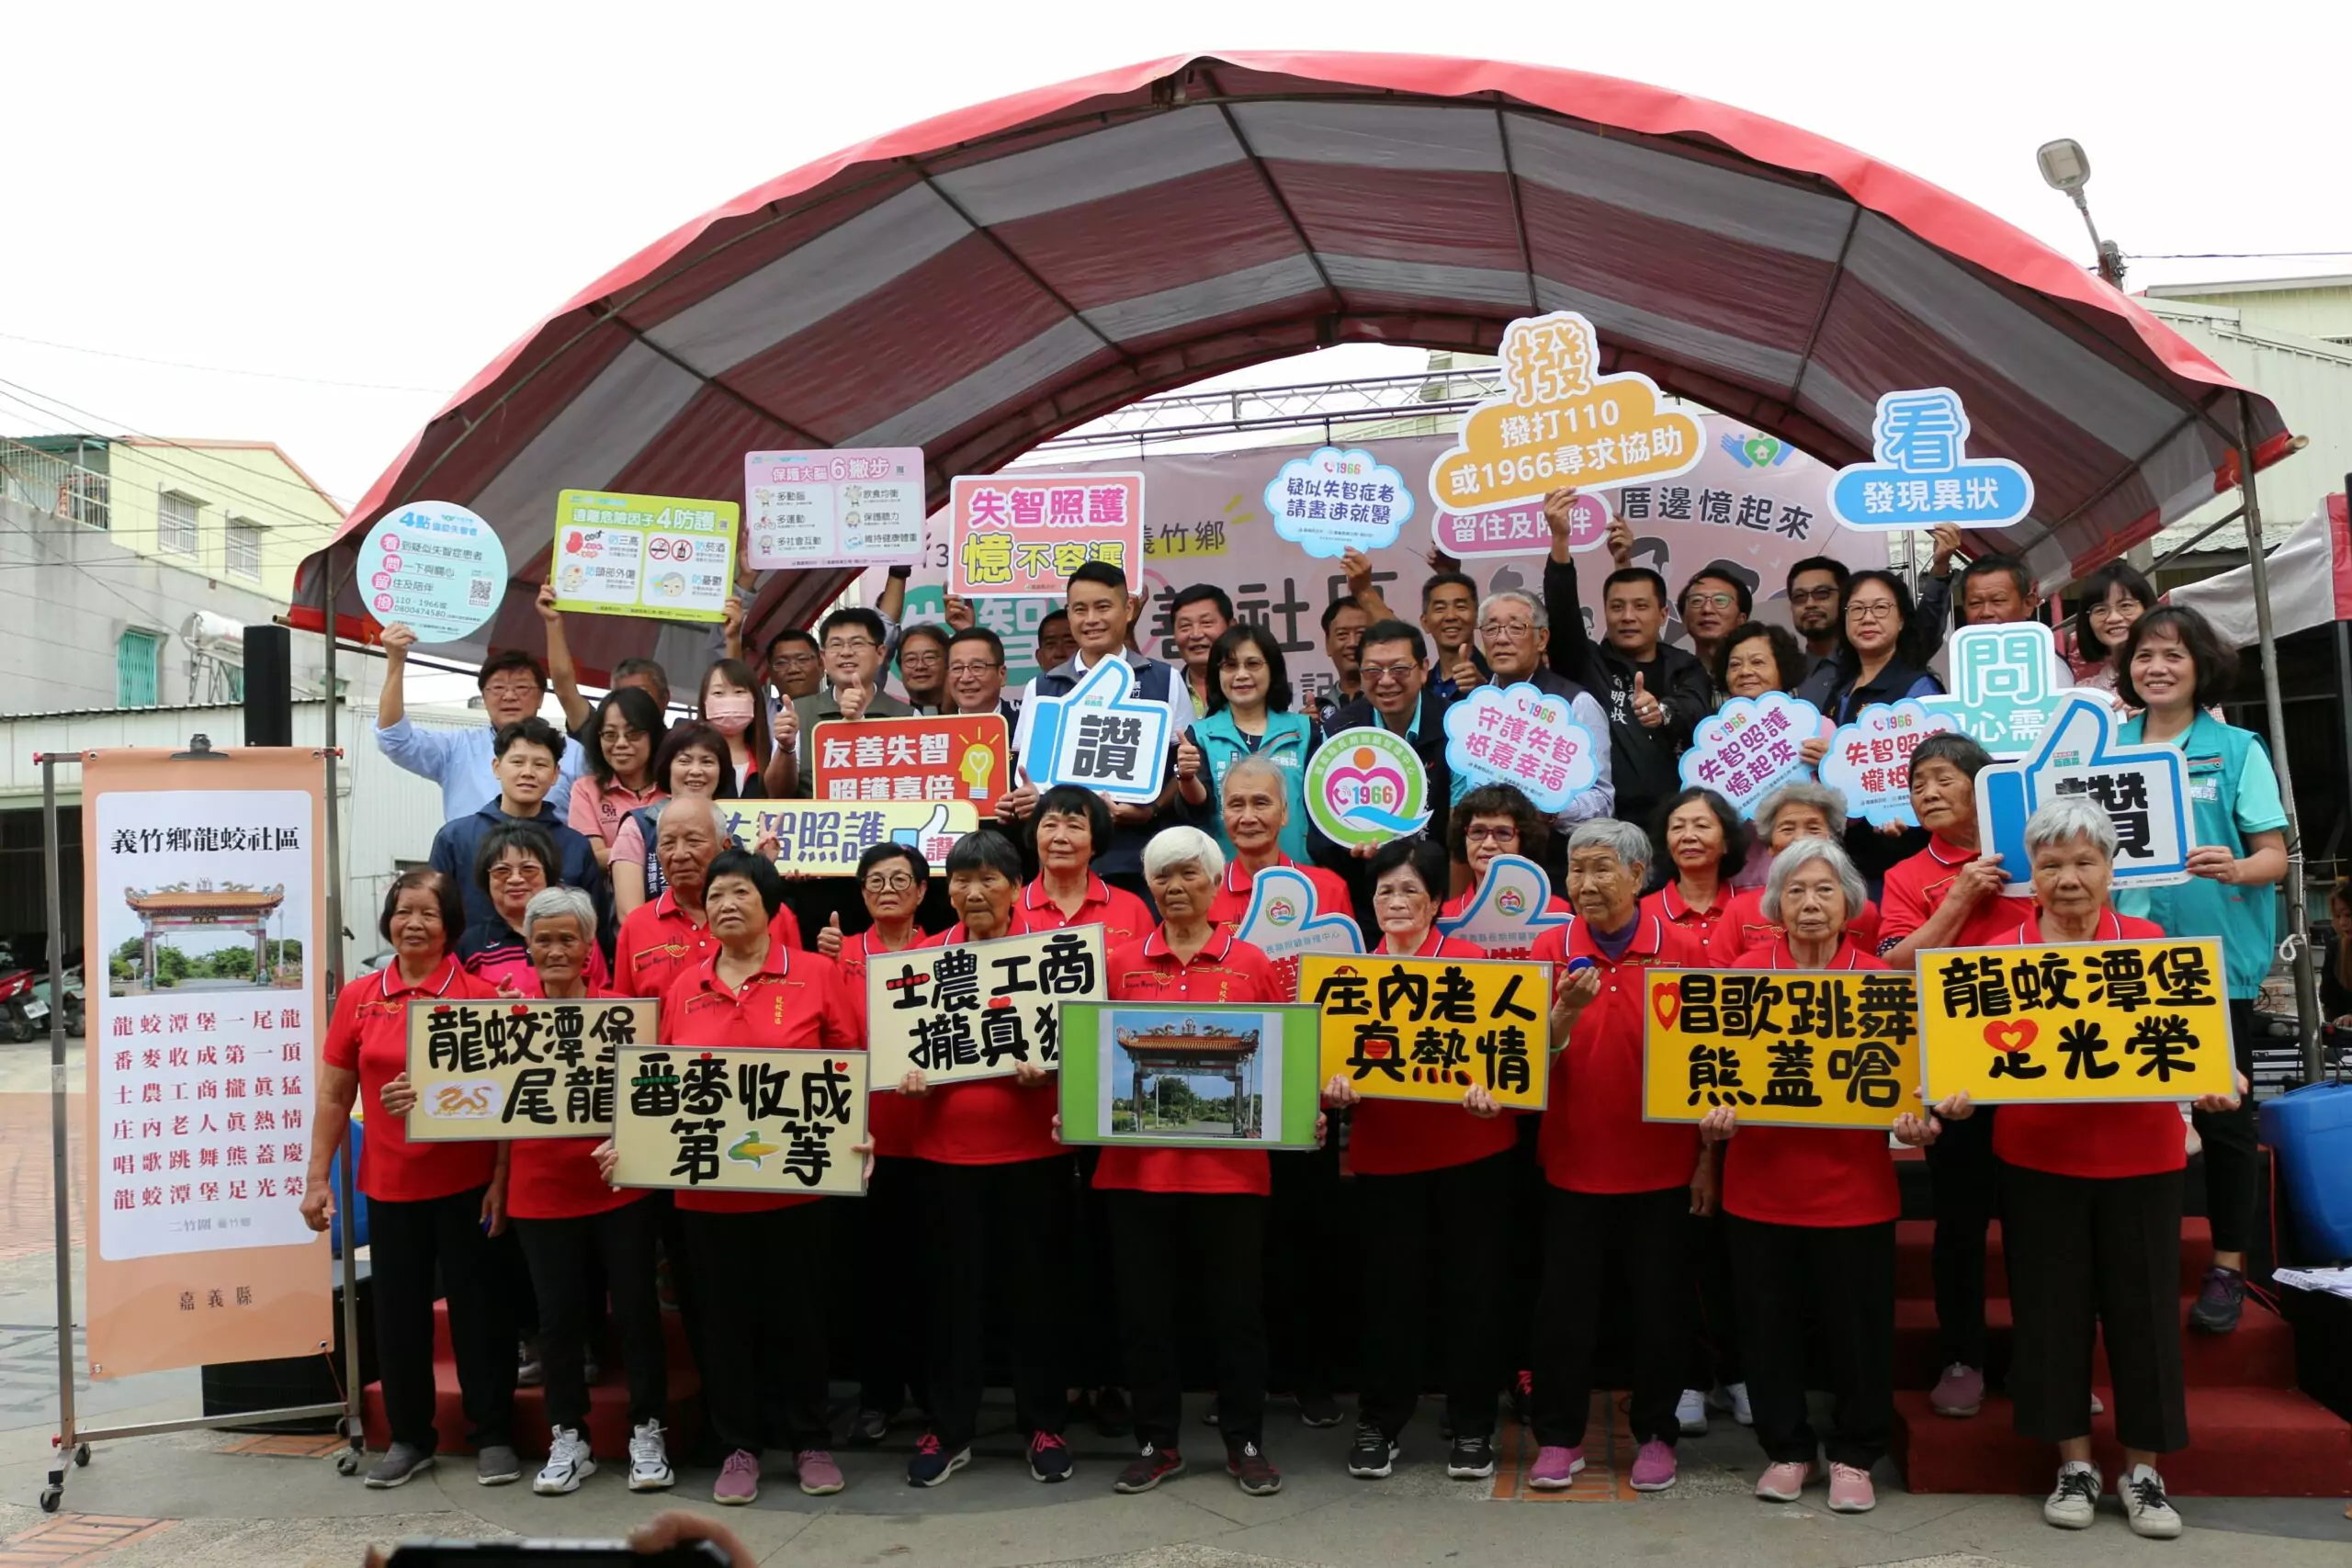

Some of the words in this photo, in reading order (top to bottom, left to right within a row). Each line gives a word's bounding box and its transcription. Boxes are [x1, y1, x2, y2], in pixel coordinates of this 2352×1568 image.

[1514, 325, 1589, 402] 撥
[1500, 400, 1620, 448] 撥打110
[1887, 399, 1958, 470] 看
[1336, 462, 1362, 475] 1966
[1450, 425, 1683, 496] 或1966尋求協助
[971, 486, 1126, 527] 失智照護
[1287, 477, 1394, 502] 疑似失智症者
[1862, 477, 1999, 514] 發現異狀
[1286, 499, 1391, 525] 請盡速就醫
[1966, 636, 2040, 705] 問
[1529, 702, 1556, 724] 1966
[1720, 713, 1747, 737] 1966
[1885, 714, 1913, 729] 1966
[822, 733, 950, 769] 友善失智
[1072, 715, 1142, 781] 讚
[1478, 706, 1578, 764] 守護失智
[1698, 706, 1792, 784] 失智照護
[1846, 728, 1946, 766] 失智照
[1725, 739, 1797, 797] 憶起來
[1352, 785, 1393, 805] 1966
[111, 827, 300, 854] 義竹鄉龍蛟社區
[886, 934, 1095, 1010] 士農工商
[1939, 946, 2217, 1020] 龍蛟潭堡
[113, 1009, 301, 1037] 龍蛟潭堡一尾龍
[427, 1005, 637, 1073] 龍蛟潭堡
[114, 1042, 301, 1071] 番麥收成第一頂
[1345, 1020, 1531, 1095] 真熱情
[501, 1066, 615, 1125] 尾龍
[113, 1143, 303, 1175] 唱歌跳舞熊蓋慶
[114, 1177, 304, 1211] 龍蛟潭堡足光榮
[179, 1286, 253, 1311] 嘉義縣
